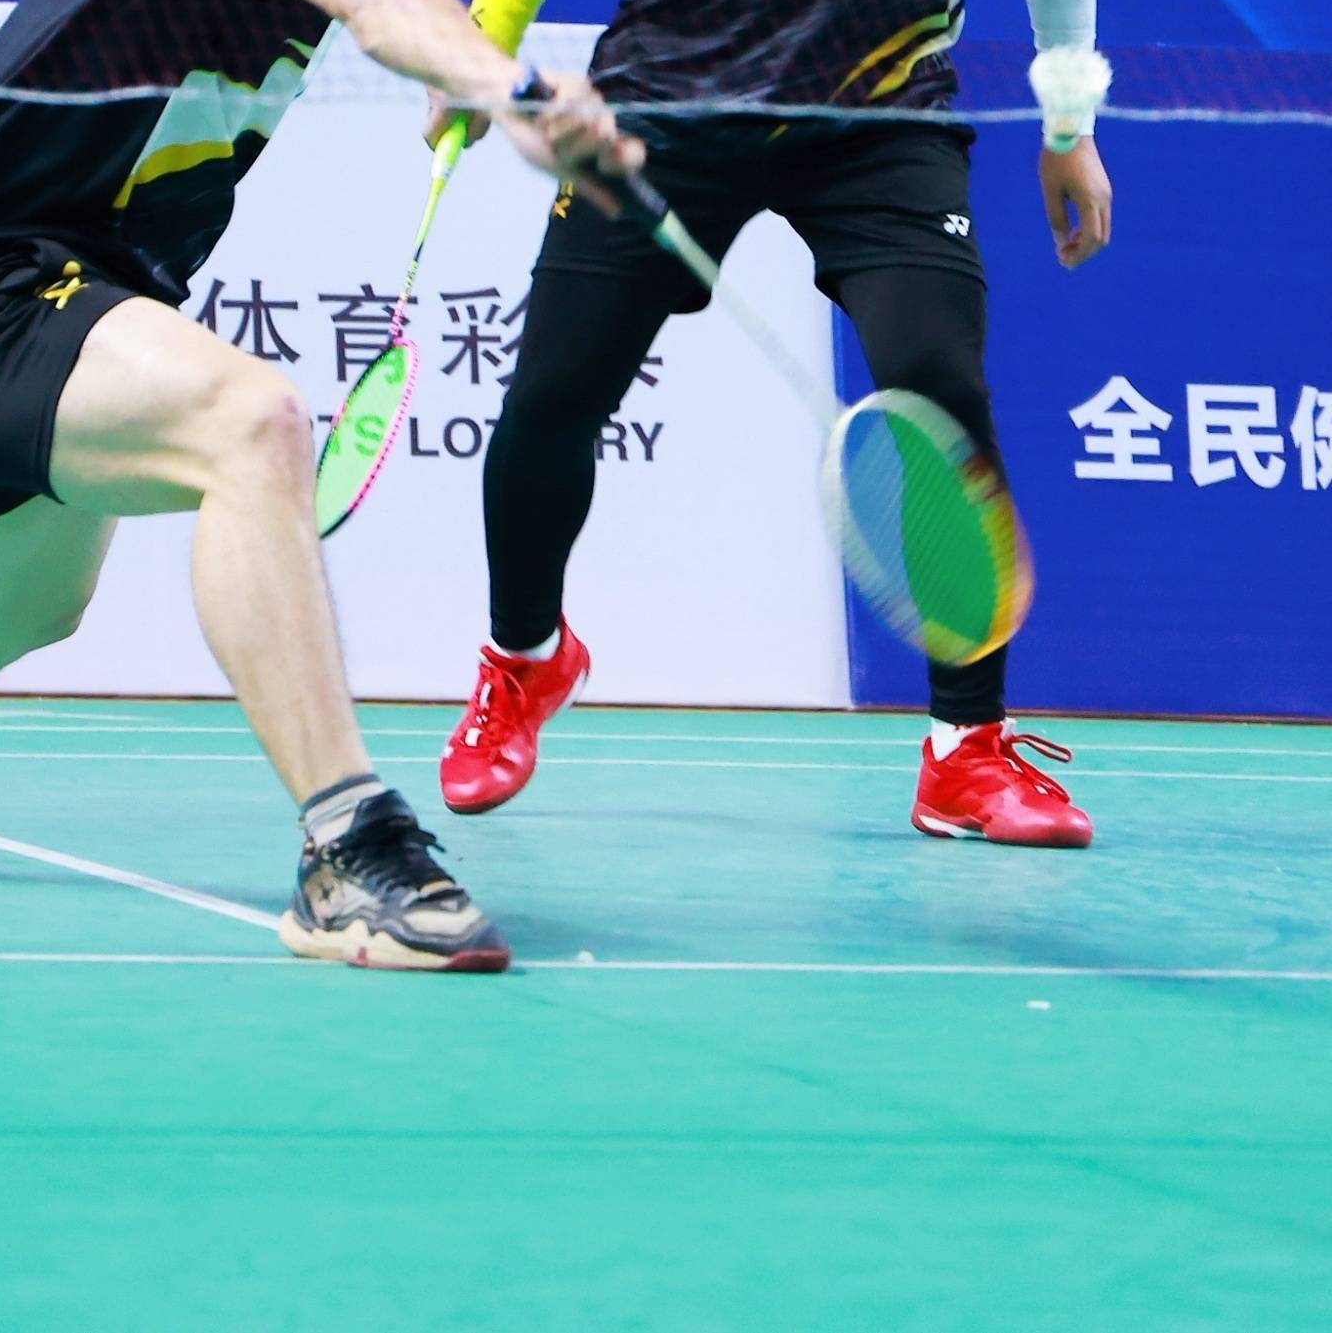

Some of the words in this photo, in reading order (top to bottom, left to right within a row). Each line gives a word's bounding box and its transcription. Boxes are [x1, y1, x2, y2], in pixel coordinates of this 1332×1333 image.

[196, 277, 664, 389] 体育彩
[409, 416, 665, 462] LORY
